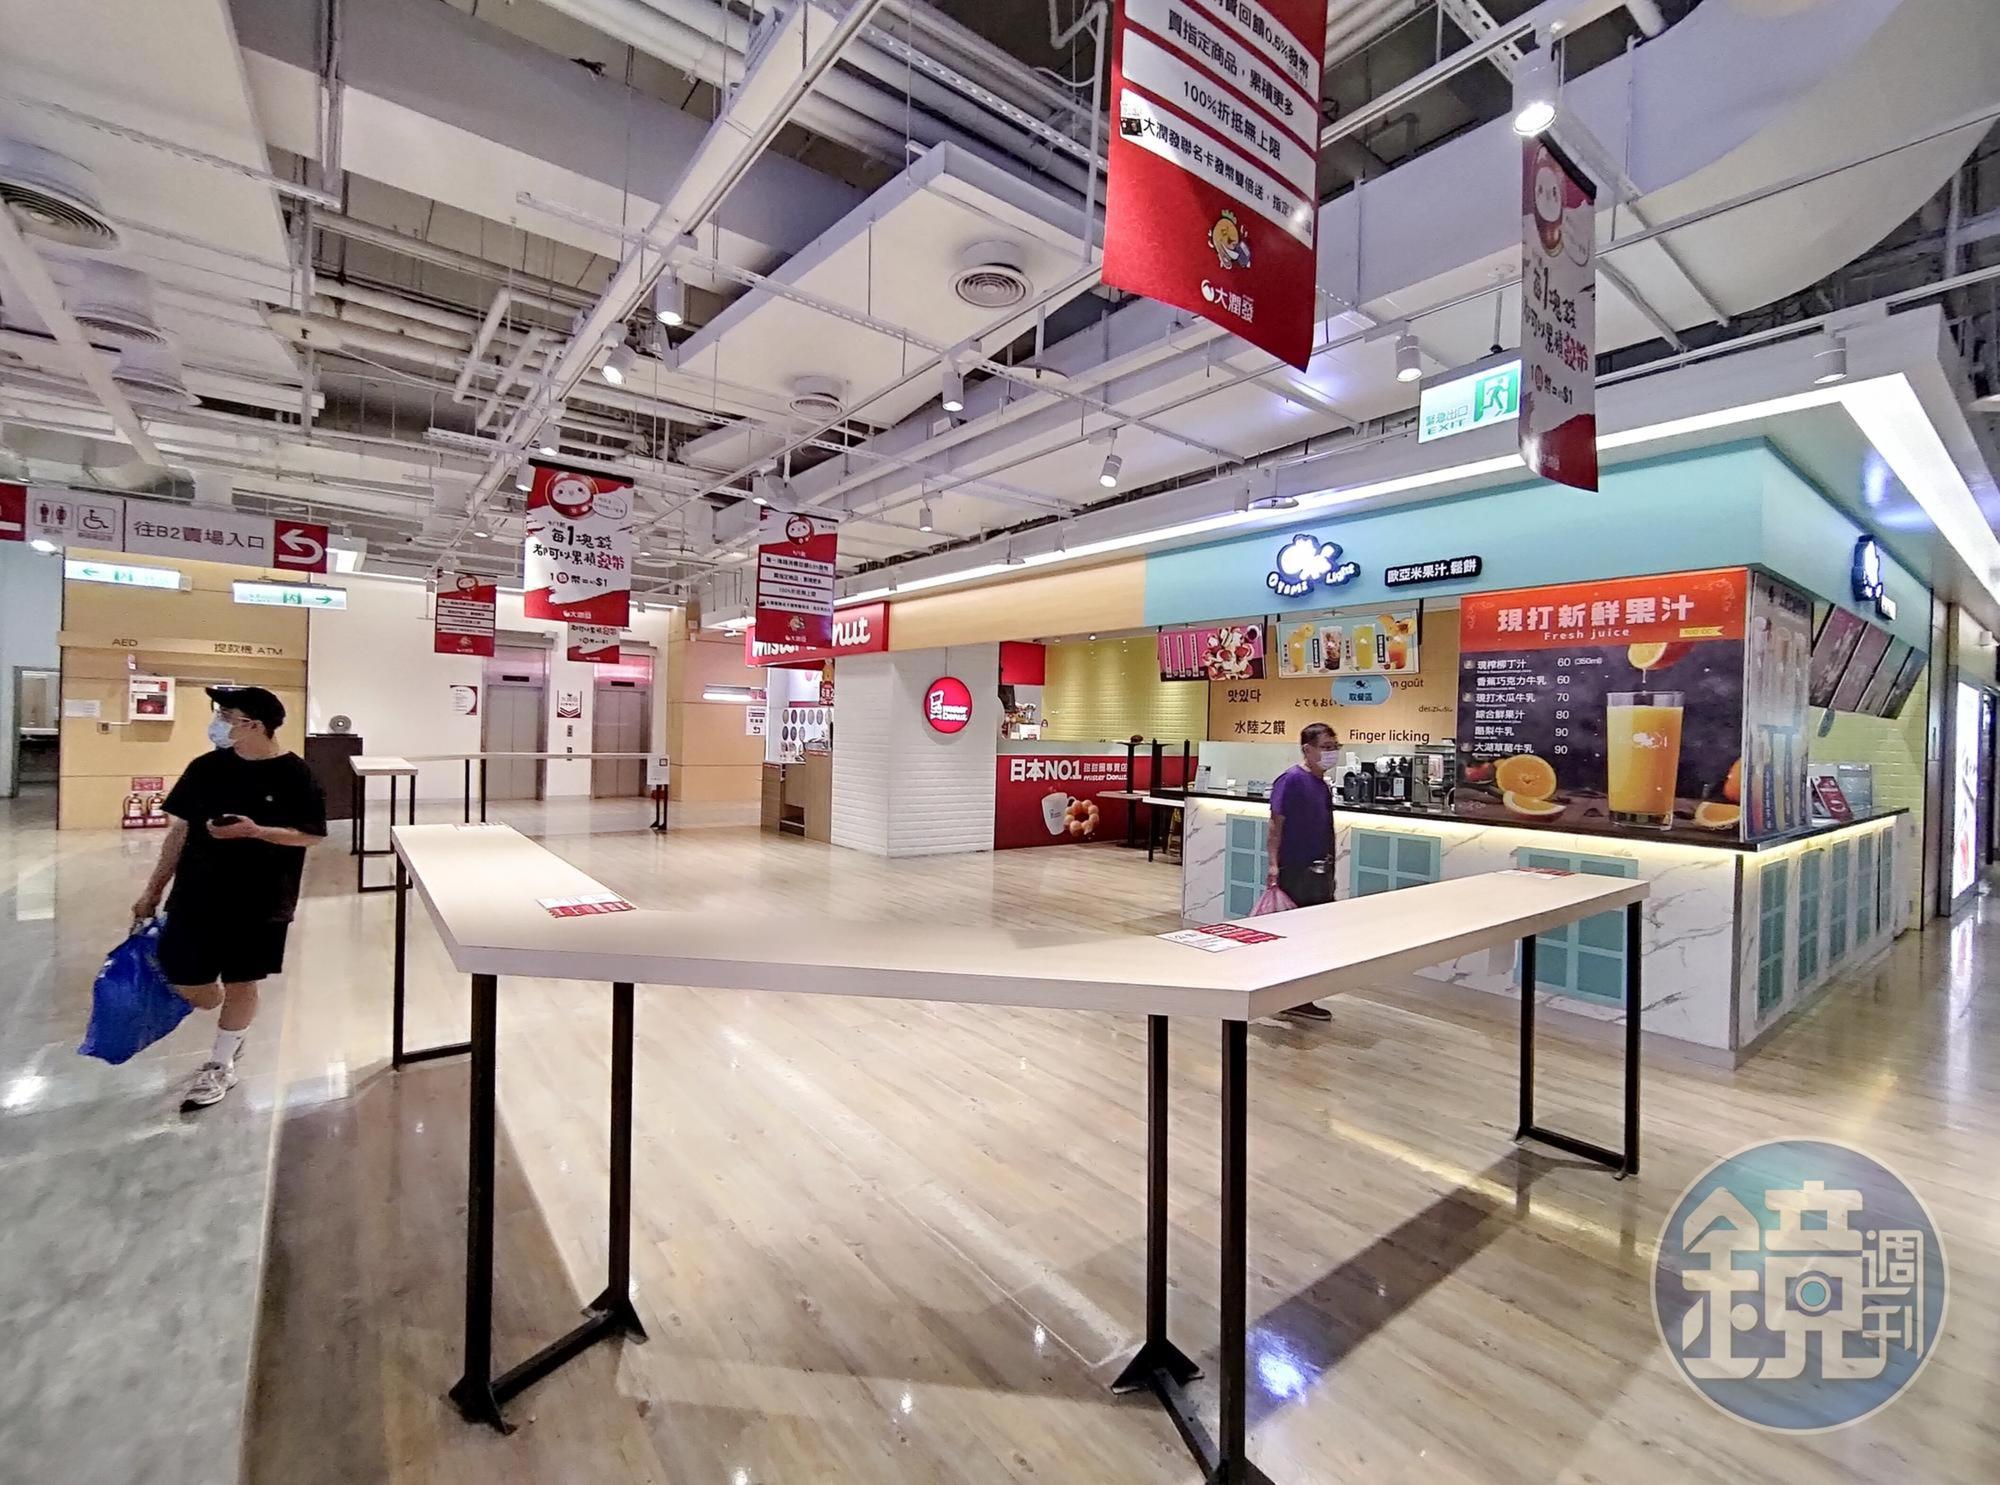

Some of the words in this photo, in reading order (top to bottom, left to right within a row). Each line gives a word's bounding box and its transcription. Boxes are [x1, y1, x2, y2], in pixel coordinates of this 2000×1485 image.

[1168, 8, 1294, 117] 買指定商品，累積更多
[1183, 80, 1282, 161] 100%折抵無上限
[1214, 286, 1254, 323] 大潤發
[1426, 403, 1469, 427] 緊急出口
[1427, 419, 1465, 437] EXIT
[133, 519, 265, 551] 往B2賣場入口
[552, 525, 613, 551] 每1塊錢
[533, 542, 625, 571] 都可以累積發幣
[1497, 594, 1695, 633] 現打新鮮果汁
[112, 637, 138, 647] AED
[1543, 630, 1584, 641] Fresh
[1590, 628, 1631, 641] juice
[214, 643, 253, 655] 提款機
[257, 647, 284, 656] ATM
[1557, 657, 1571, 667] 60
[1400, 678, 1424, 690] goût
[1476, 675, 1547, 687] 香蕉巧克力牛乳
[1557, 675, 1570, 684] 60
[1227, 688, 1262, 703] 맛있다
[1475, 692, 1536, 703] 現打木瓜牛乳
[1556, 692, 1570, 702] 70
[1475, 709, 1526, 720] 綜合鮮果汁
[1555, 710, 1570, 720] 80
[1349, 729, 1386, 743] Finger
[1388, 729, 1430, 744] licking
[1555, 727, 1569, 737] 90
[1554, 745, 1568, 755] 90
[1010, 758, 1082, 782] 日本NO.1
